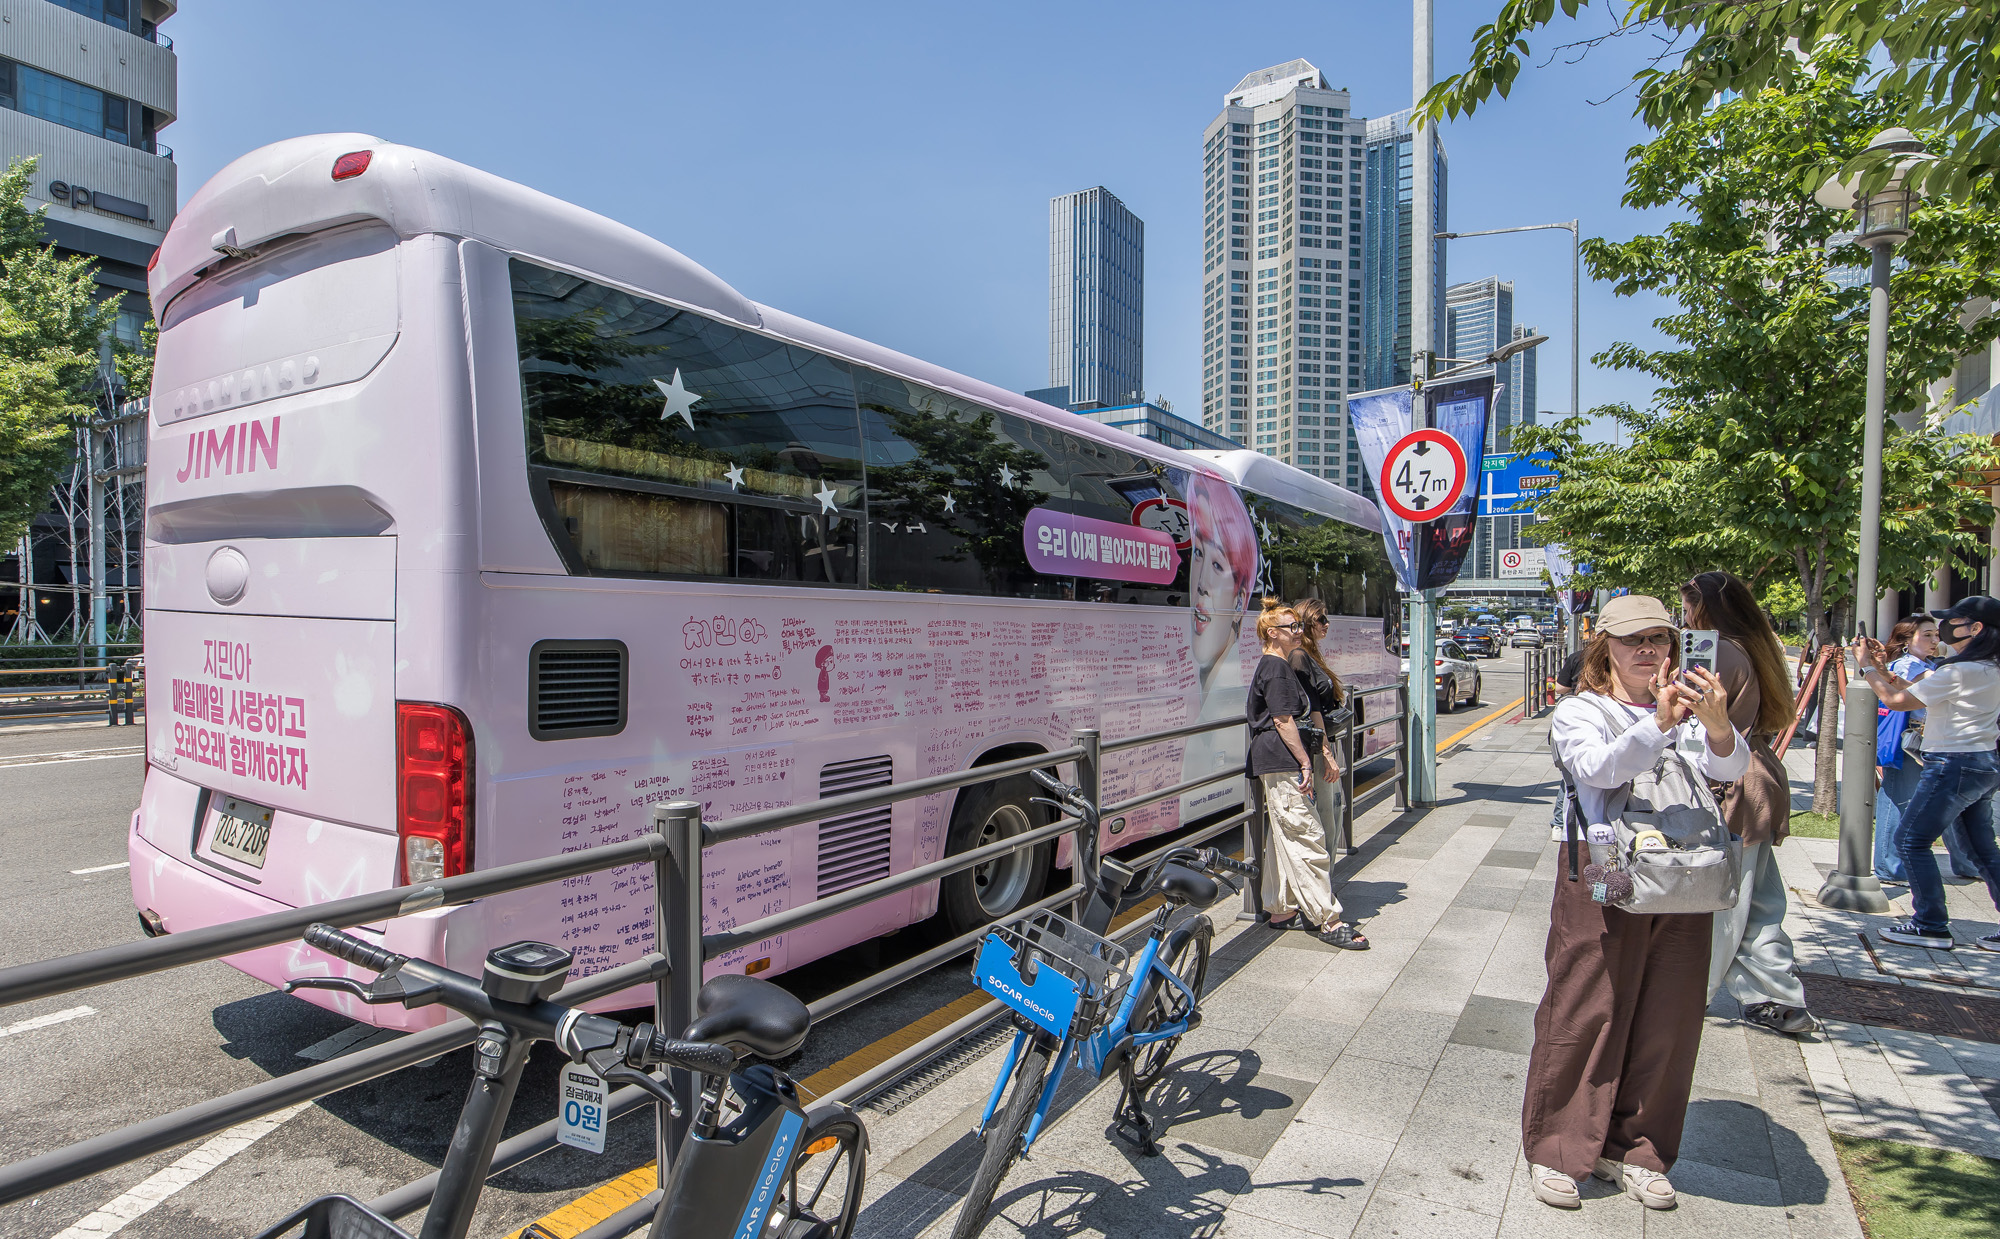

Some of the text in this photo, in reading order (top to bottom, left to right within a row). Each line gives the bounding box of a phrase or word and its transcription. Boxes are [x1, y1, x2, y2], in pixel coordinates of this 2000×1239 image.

[176, 416, 281, 484] JIMIN
[1484, 459, 1506, 469] 각지역
[1395, 459, 1448, 494] 4.7m
[1037, 525, 1171, 571] 우리 이제 떨어지지 말자
[203, 639, 252, 683] 지민아
[171, 678, 307, 739] 매일매일 사랑하고
[731, 698, 806, 714] FOR GIVING ME SO MANY
[740, 687, 800, 703] JIMIN THANK YOU
[729, 717, 752, 726] SMILES
[731, 727, 748, 736] LOVE
[769, 721, 785, 732] LOVE
[174, 720, 309, 791] 오래오래 함께하자
[649, 775, 670, 787] 지민아
[737, 868, 761, 882] Welcome
[763, 862, 778, 873] home
[988, 975, 1055, 1022] SOCAR elecle
[565, 1085, 603, 1105] 잠금해제
[565, 1100, 602, 1133] 0원
[741, 1206, 762, 1239] CAR
